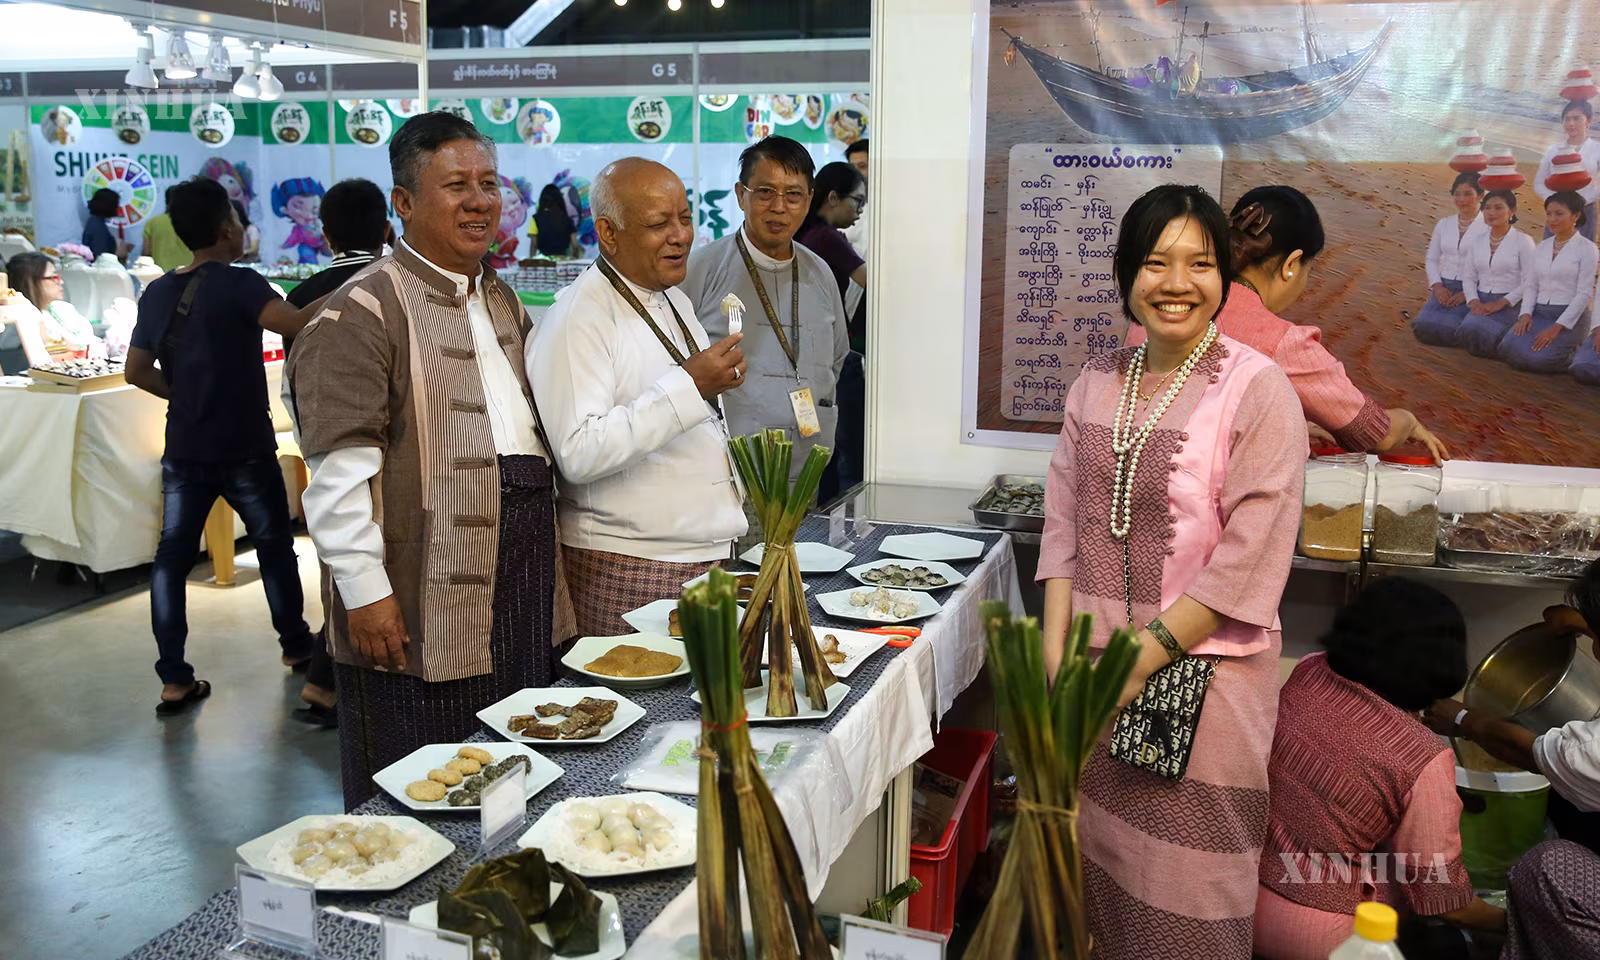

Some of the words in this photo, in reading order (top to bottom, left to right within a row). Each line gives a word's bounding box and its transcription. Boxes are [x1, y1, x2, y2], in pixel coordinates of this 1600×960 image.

[389, 10, 398, 28] F
[401, 12, 408, 30] 5
[295, 71, 307, 84] G
[309, 71, 317, 83] 4
[652, 64, 664, 77] G
[667, 63, 677, 76] 5
[54, 151, 129, 177] SHU
[137, 154, 180, 179] SEIN
[1021, 174, 1055, 189] ထမင်း
[1019, 220, 1062, 240] ကျောင်း
